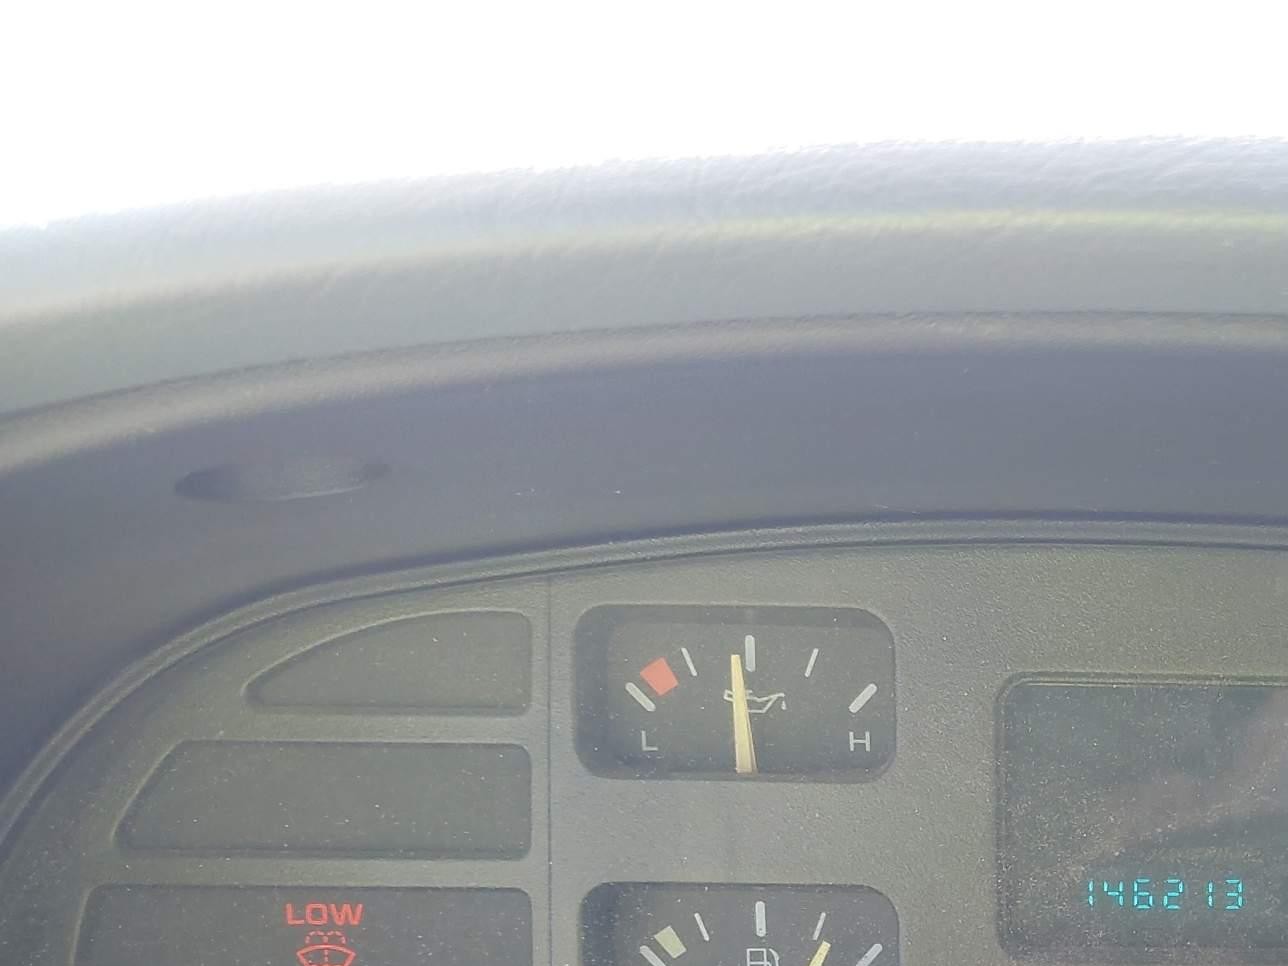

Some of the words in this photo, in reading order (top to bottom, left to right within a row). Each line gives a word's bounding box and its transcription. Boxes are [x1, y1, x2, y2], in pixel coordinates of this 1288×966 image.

[641, 730, 658, 751] L
[850, 731, 870, 751] H
[1088, 878, 1243, 910] 146213
[285, 903, 364, 926] LOW
